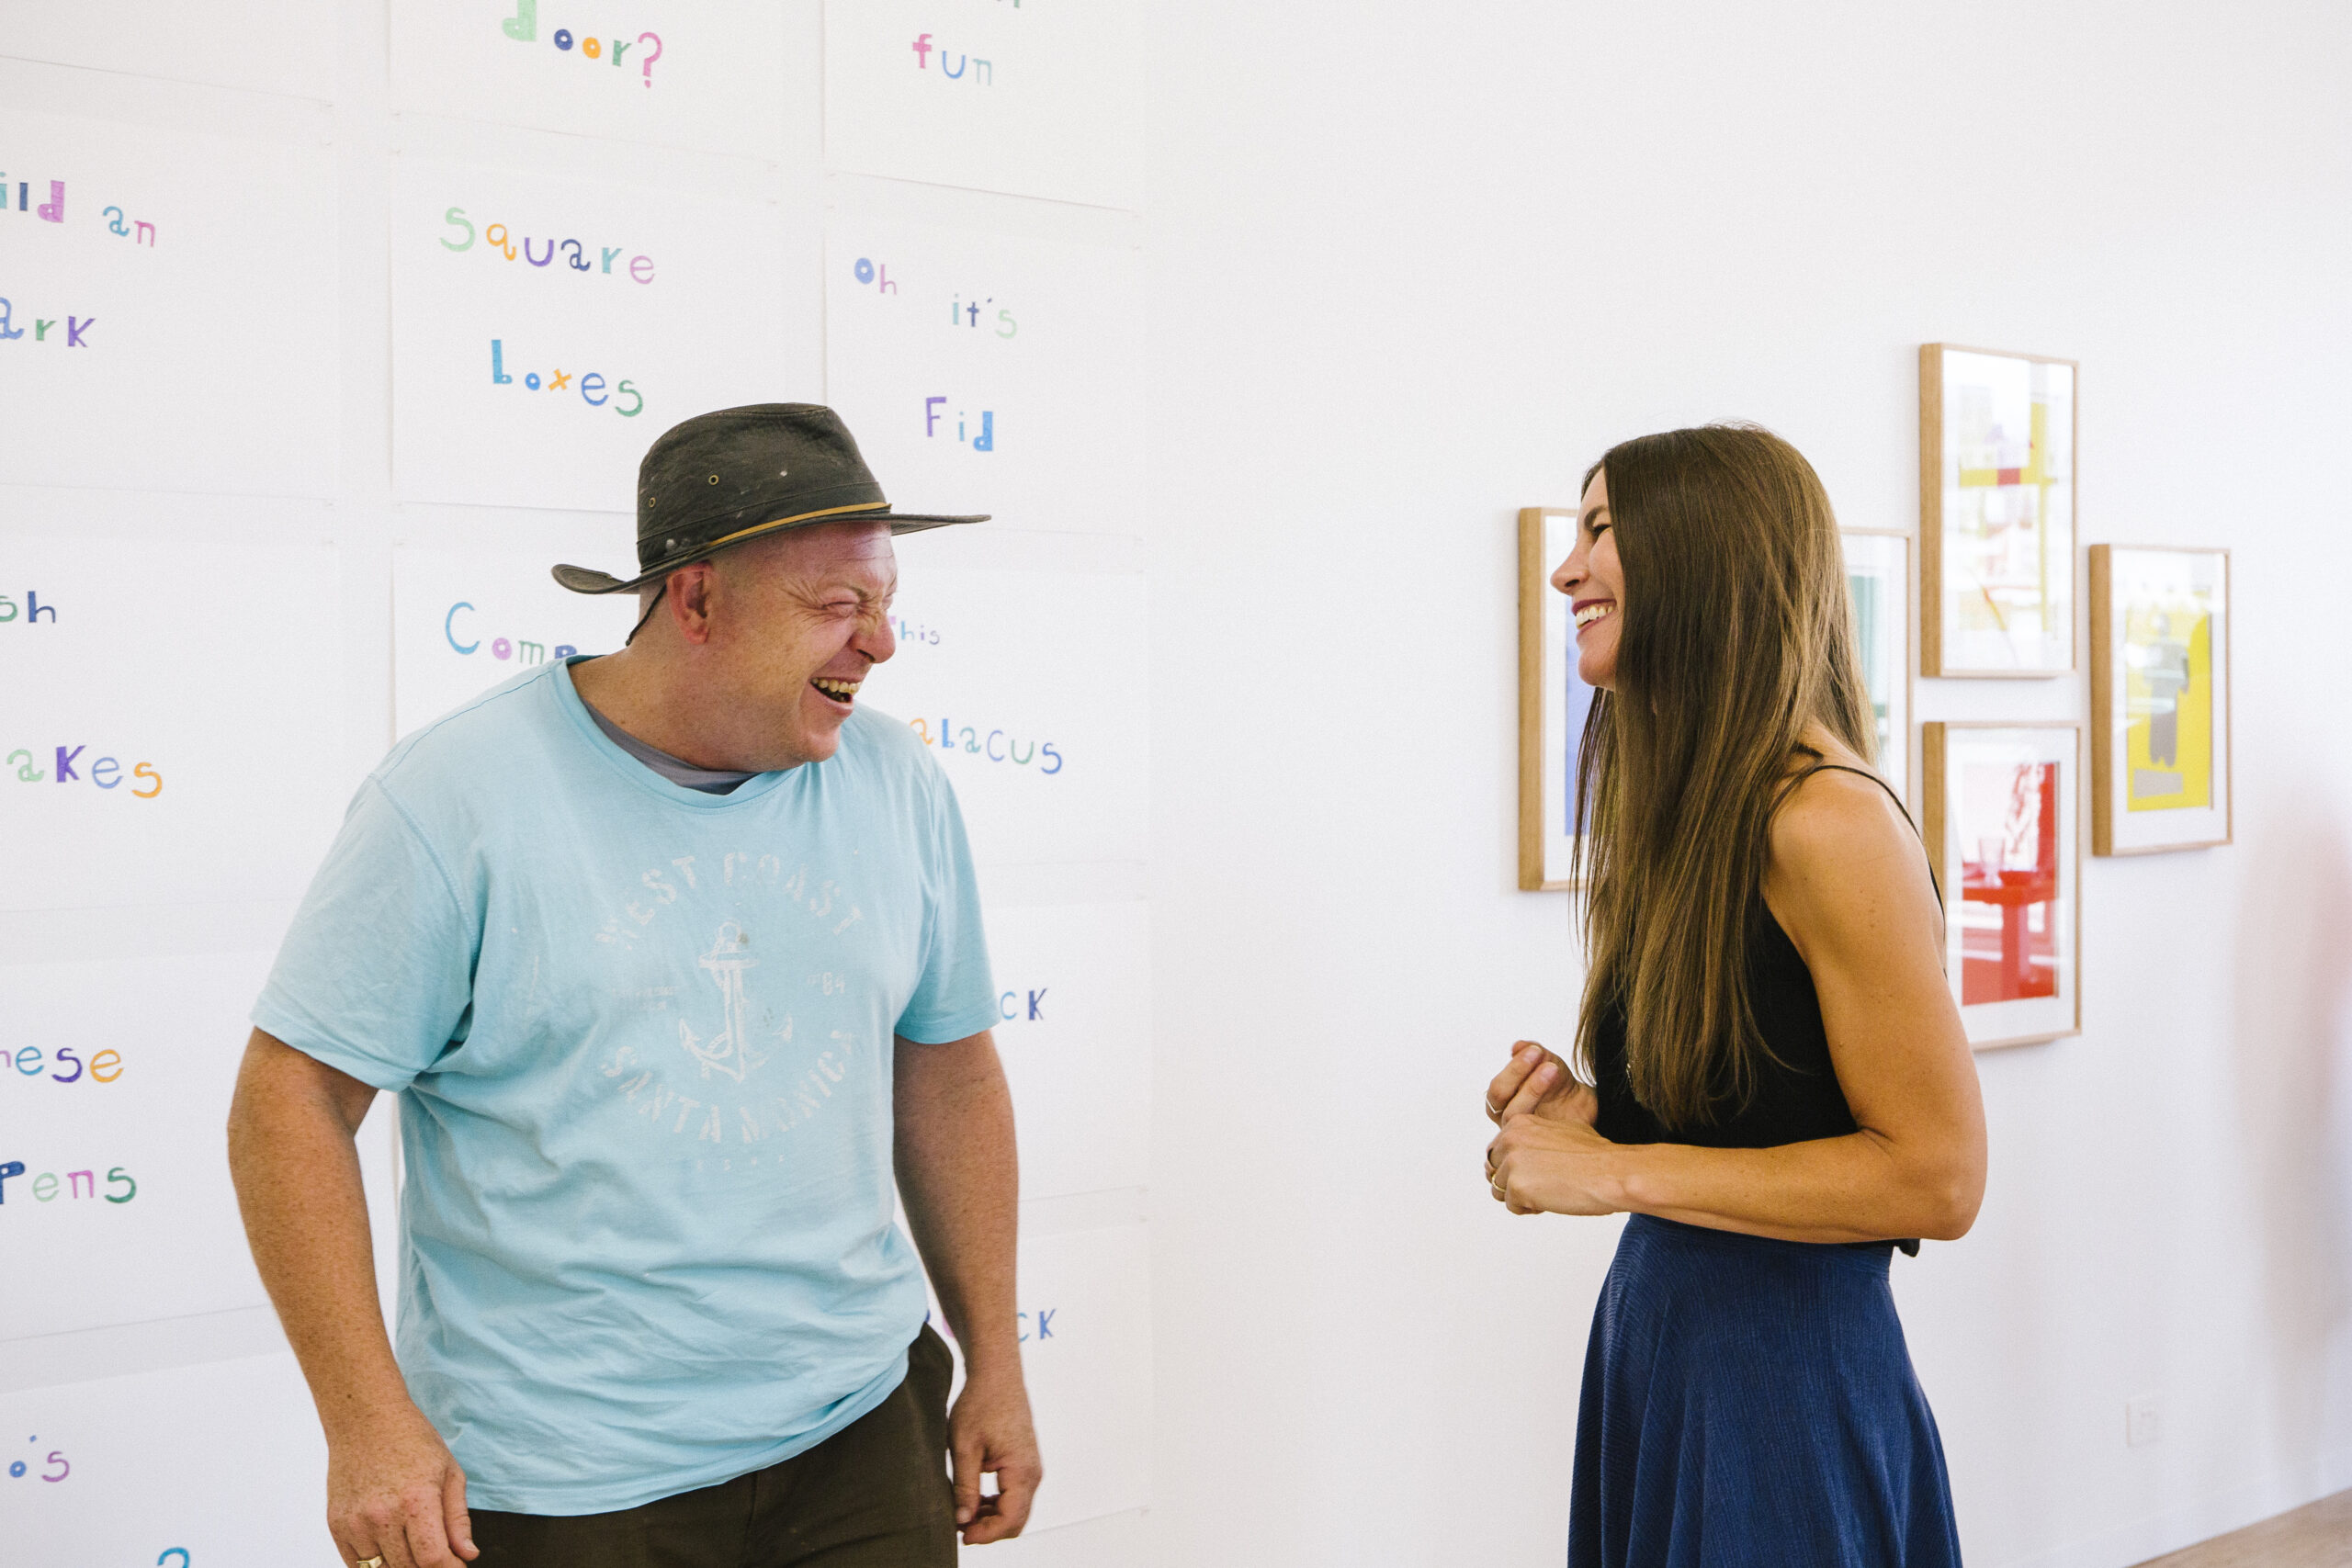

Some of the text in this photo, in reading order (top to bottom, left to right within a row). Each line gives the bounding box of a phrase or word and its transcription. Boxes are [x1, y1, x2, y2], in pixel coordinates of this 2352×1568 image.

[503, 0, 663, 89] door?
[911, 33, 993, 86] fun
[102, 206, 155, 247] an
[439, 207, 655, 285] Square
[951, 293, 1018, 339] it's
[926, 397, 993, 452] Fid
[888, 615, 941, 645] his
[723, 852, 864, 935] COAST
